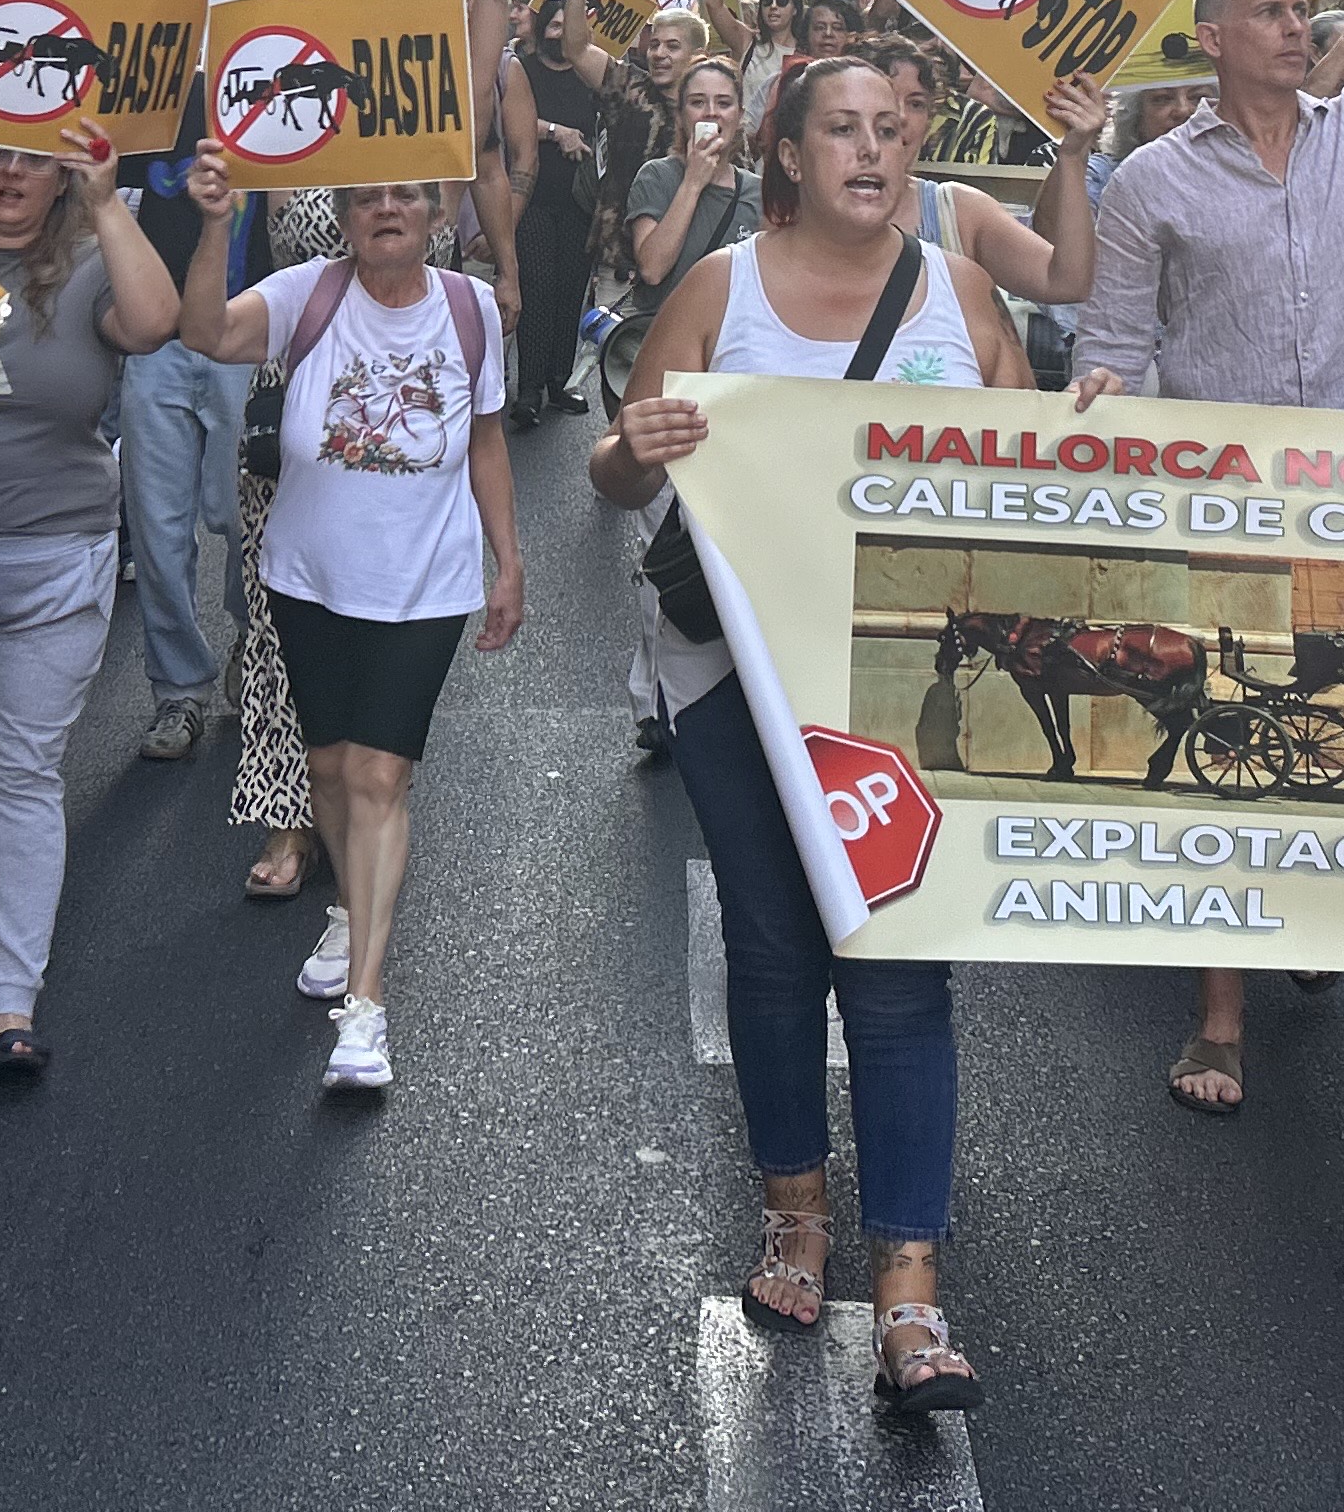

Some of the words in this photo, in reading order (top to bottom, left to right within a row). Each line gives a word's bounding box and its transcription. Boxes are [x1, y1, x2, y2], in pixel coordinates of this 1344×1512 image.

[97, 20, 192, 115] BASTA
[351, 32, 463, 138] BASTA
[866, 421, 1264, 484] MALLORCA
[849, 474, 1168, 530] CALESAS
[1188, 493, 1286, 537] DE
[992, 878, 1285, 929] ANIMAL
